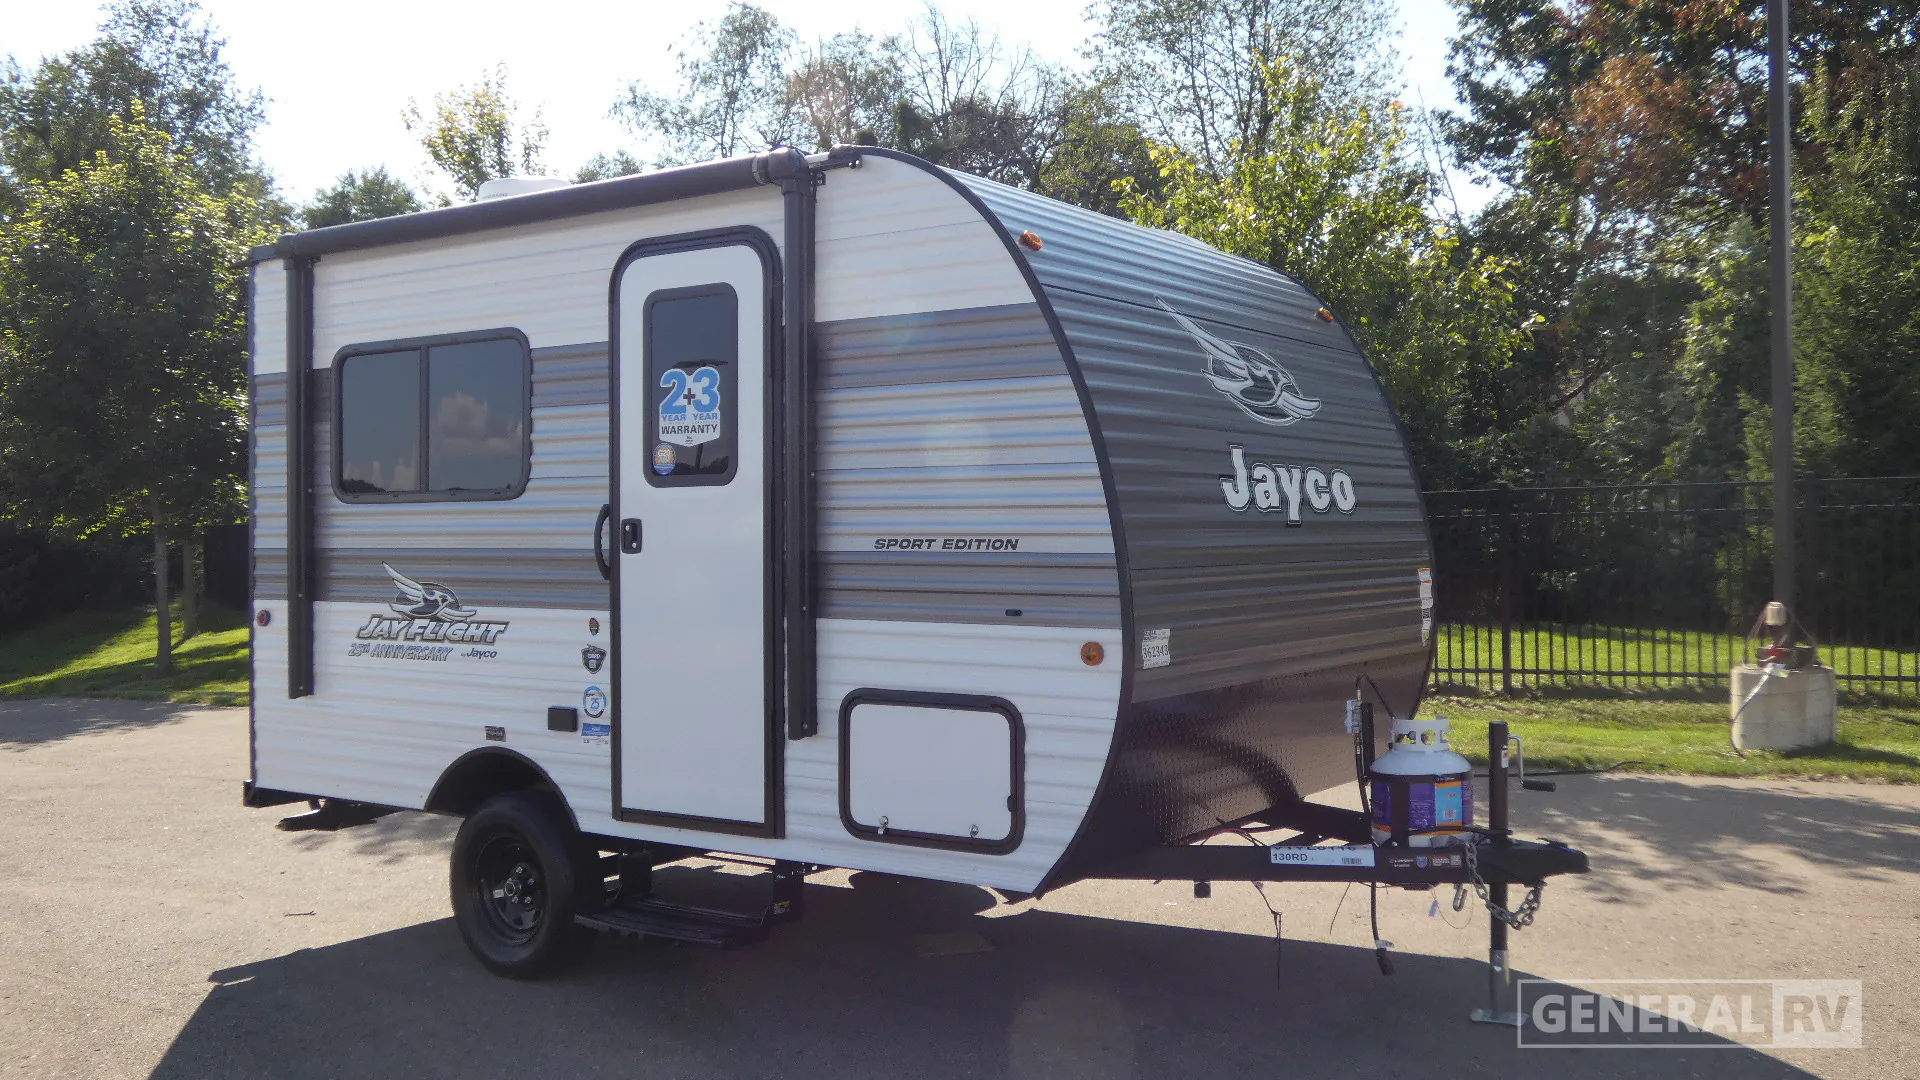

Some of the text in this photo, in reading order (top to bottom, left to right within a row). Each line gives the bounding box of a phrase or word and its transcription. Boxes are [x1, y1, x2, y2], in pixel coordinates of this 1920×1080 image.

[662, 414, 687, 422] YEAR
[693, 412, 718, 421] YEAR
[661, 424, 718, 435] WARRANTY
[1221, 444, 1357, 524] Jayco
[874, 538, 1019, 550] SPORT EDITION
[370, 643, 454, 662] ANNIVERSARY
[466, 647, 498, 660] Jayco
[1272, 853, 1308, 862] 130RD
